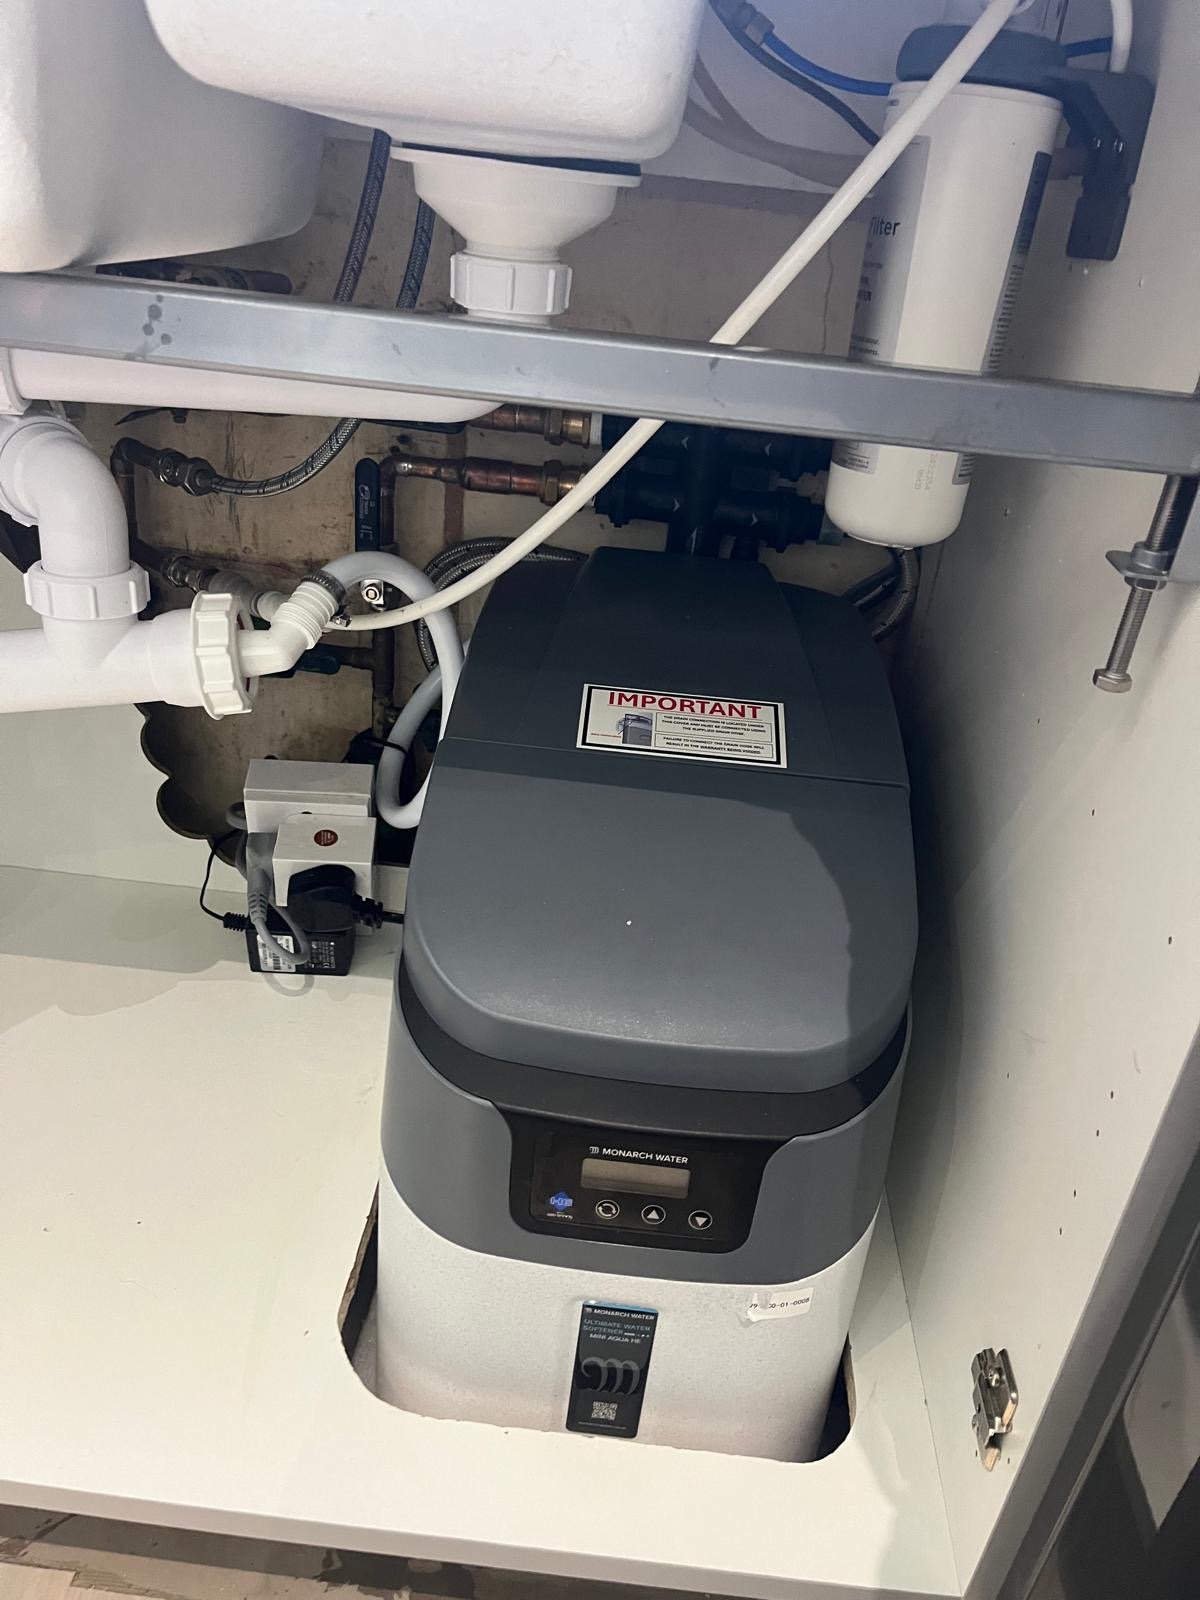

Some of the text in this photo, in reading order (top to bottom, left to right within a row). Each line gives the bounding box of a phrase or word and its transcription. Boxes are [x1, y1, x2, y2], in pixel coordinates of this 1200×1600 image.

[608, 692, 762, 719] IMPORTANT
[602, 1148, 688, 1164] MONARCH WATER
[594, 1309, 629, 1318] MONARCH
[584, 1319, 621, 1328] ULTIMATE
[583, 1325, 623, 1334] SOFTENER
